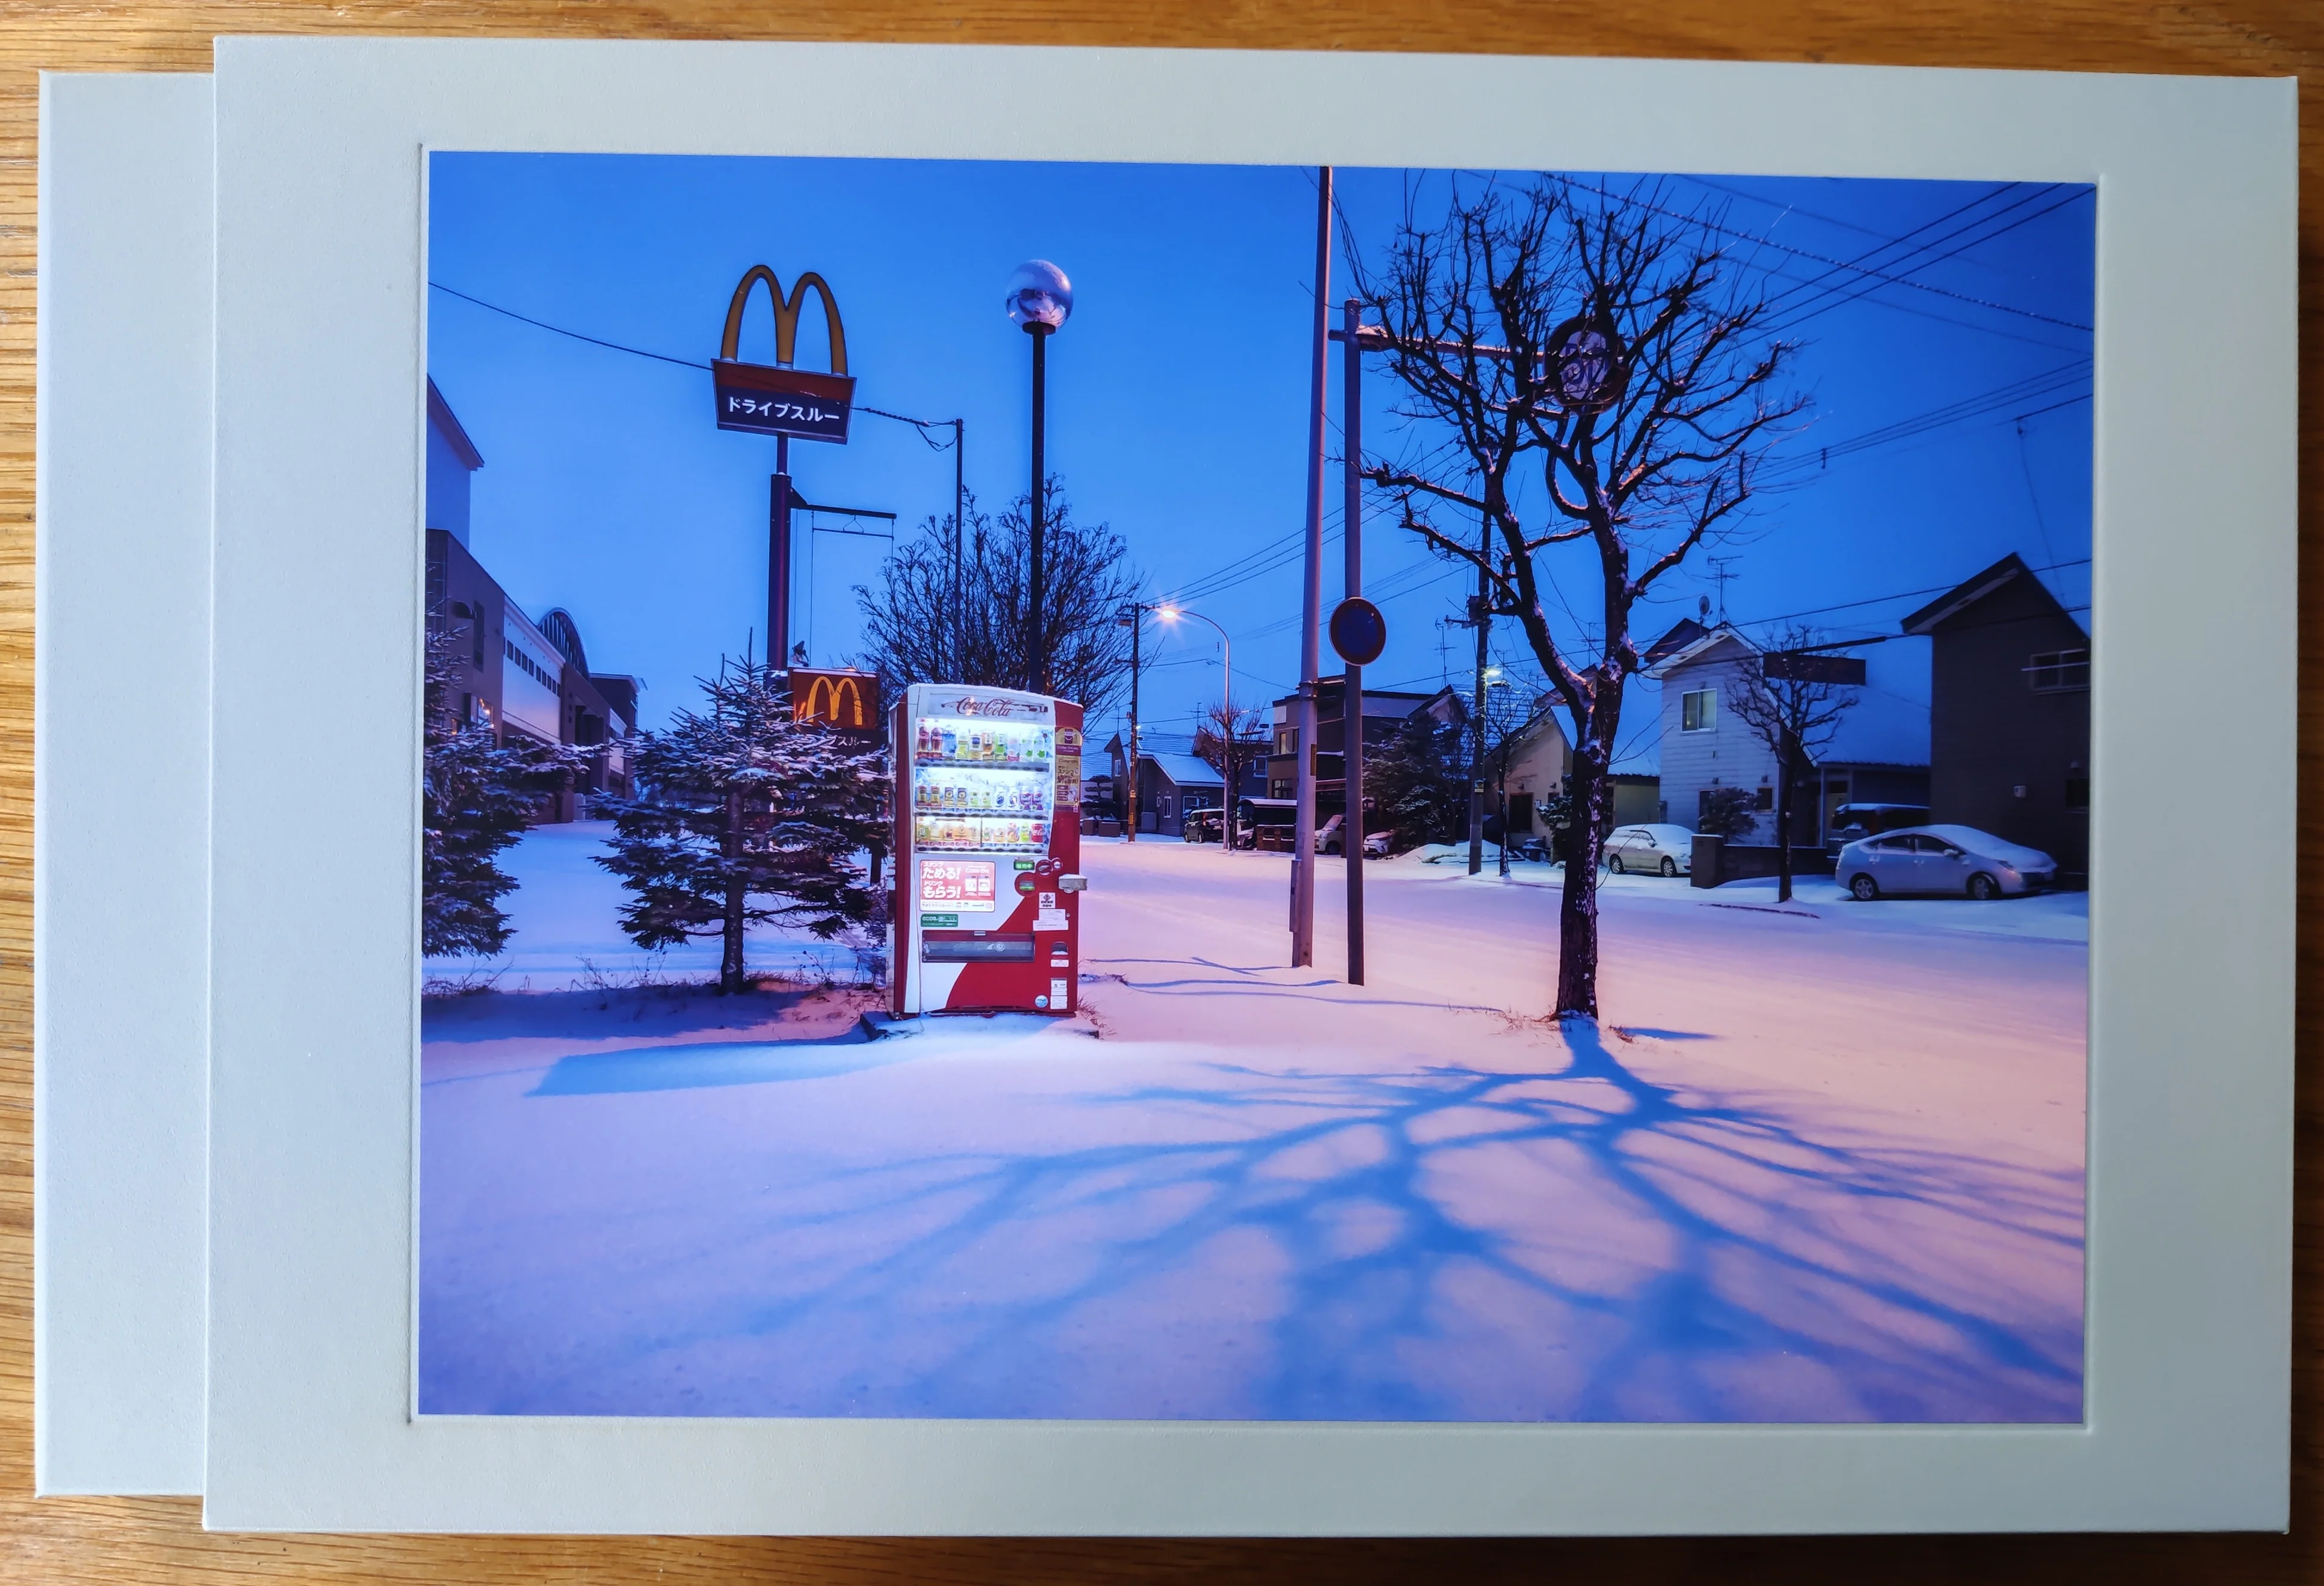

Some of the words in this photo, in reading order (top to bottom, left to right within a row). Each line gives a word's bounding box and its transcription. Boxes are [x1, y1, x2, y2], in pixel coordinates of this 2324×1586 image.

[729, 396, 840, 422] ドライブスルー
[922, 867, 961, 880] ためる!
[923, 886, 961, 899] もらう!
